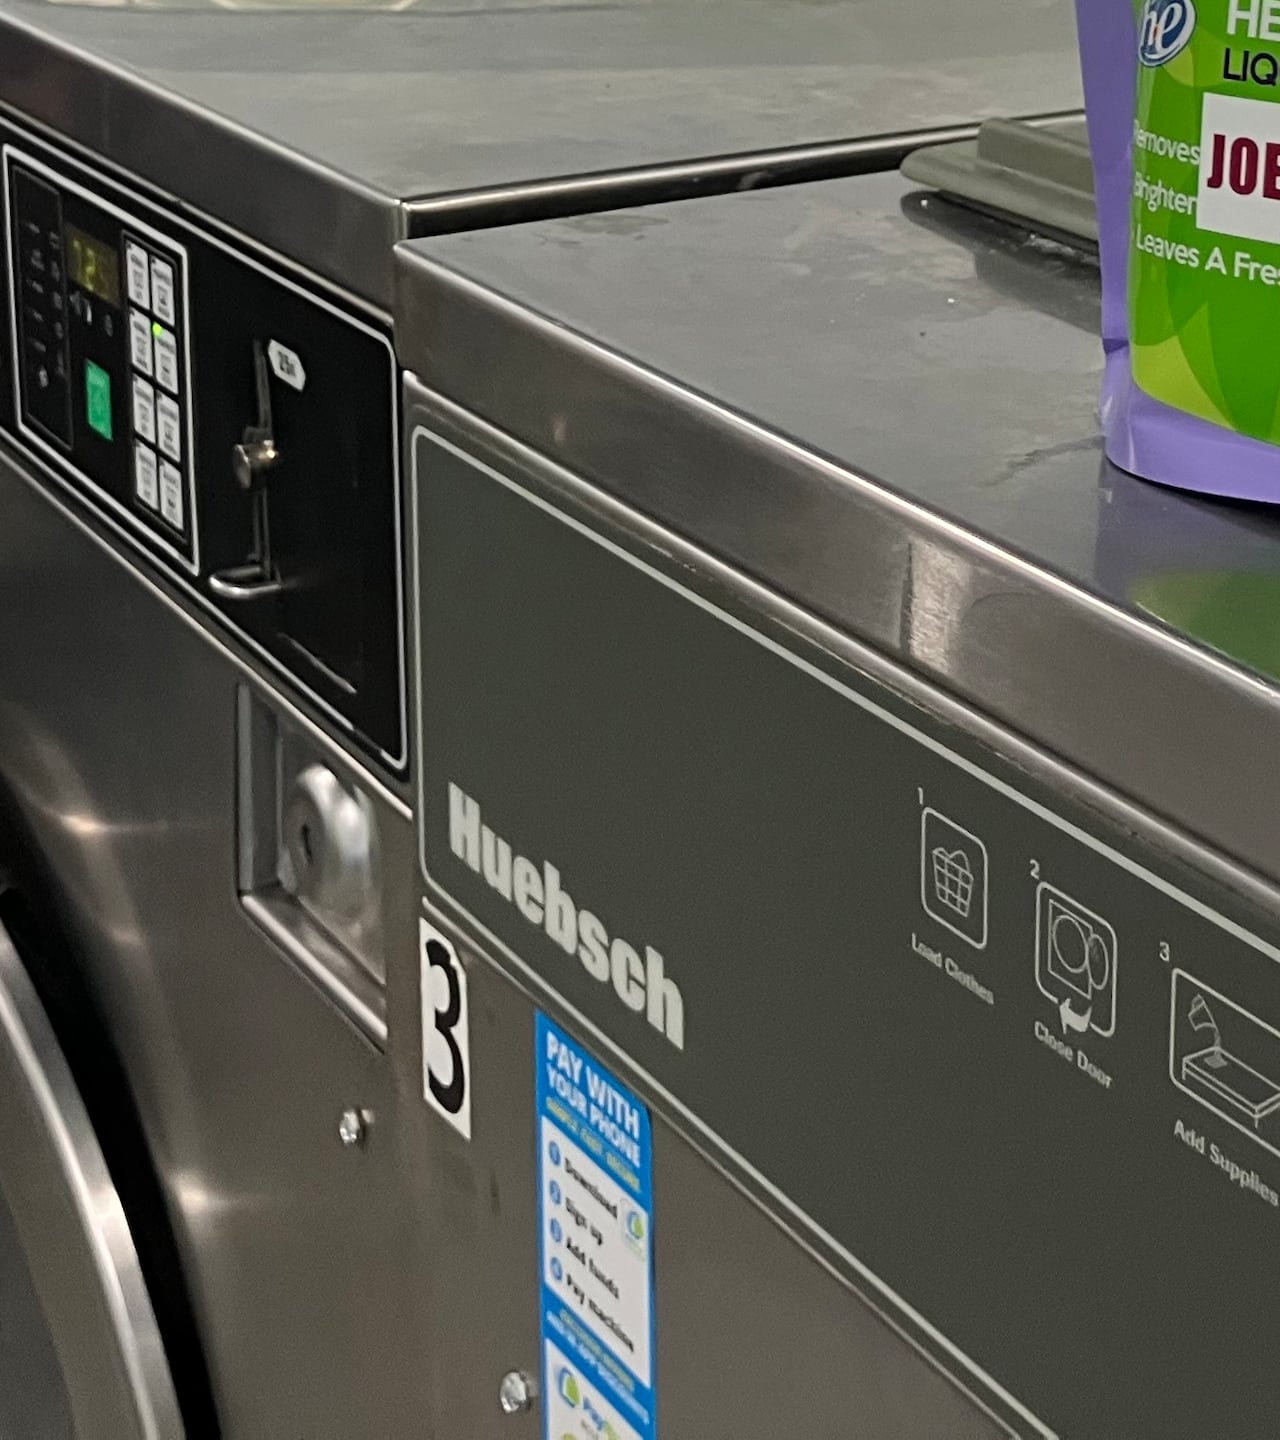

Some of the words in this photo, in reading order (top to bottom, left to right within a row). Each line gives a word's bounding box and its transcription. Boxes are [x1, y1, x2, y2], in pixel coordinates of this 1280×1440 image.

[1135, 223, 1200, 268] Leaves
[1205, 246, 1227, 276] A
[1030, 858, 1041, 880] 2
[448, 781, 684, 1051] Huebsch
[1158, 940, 1171, 962] 3
[911, 932, 942, 970] Load
[945, 957, 994, 1007] Clothes
[425, 938, 465, 1115] 3
[1034, 1020, 1074, 1062] Close
[1076, 1049, 1113, 1090] Door
[545, 1030, 583, 1085] PAY
[585, 1065, 640, 1141] WITH
[545, 1062, 588, 1119] YOUR
[590, 1102, 640, 1169] PHONE
[1173, 1118, 1206, 1157] Add
[1209, 1143, 1280, 1208] Supplies
